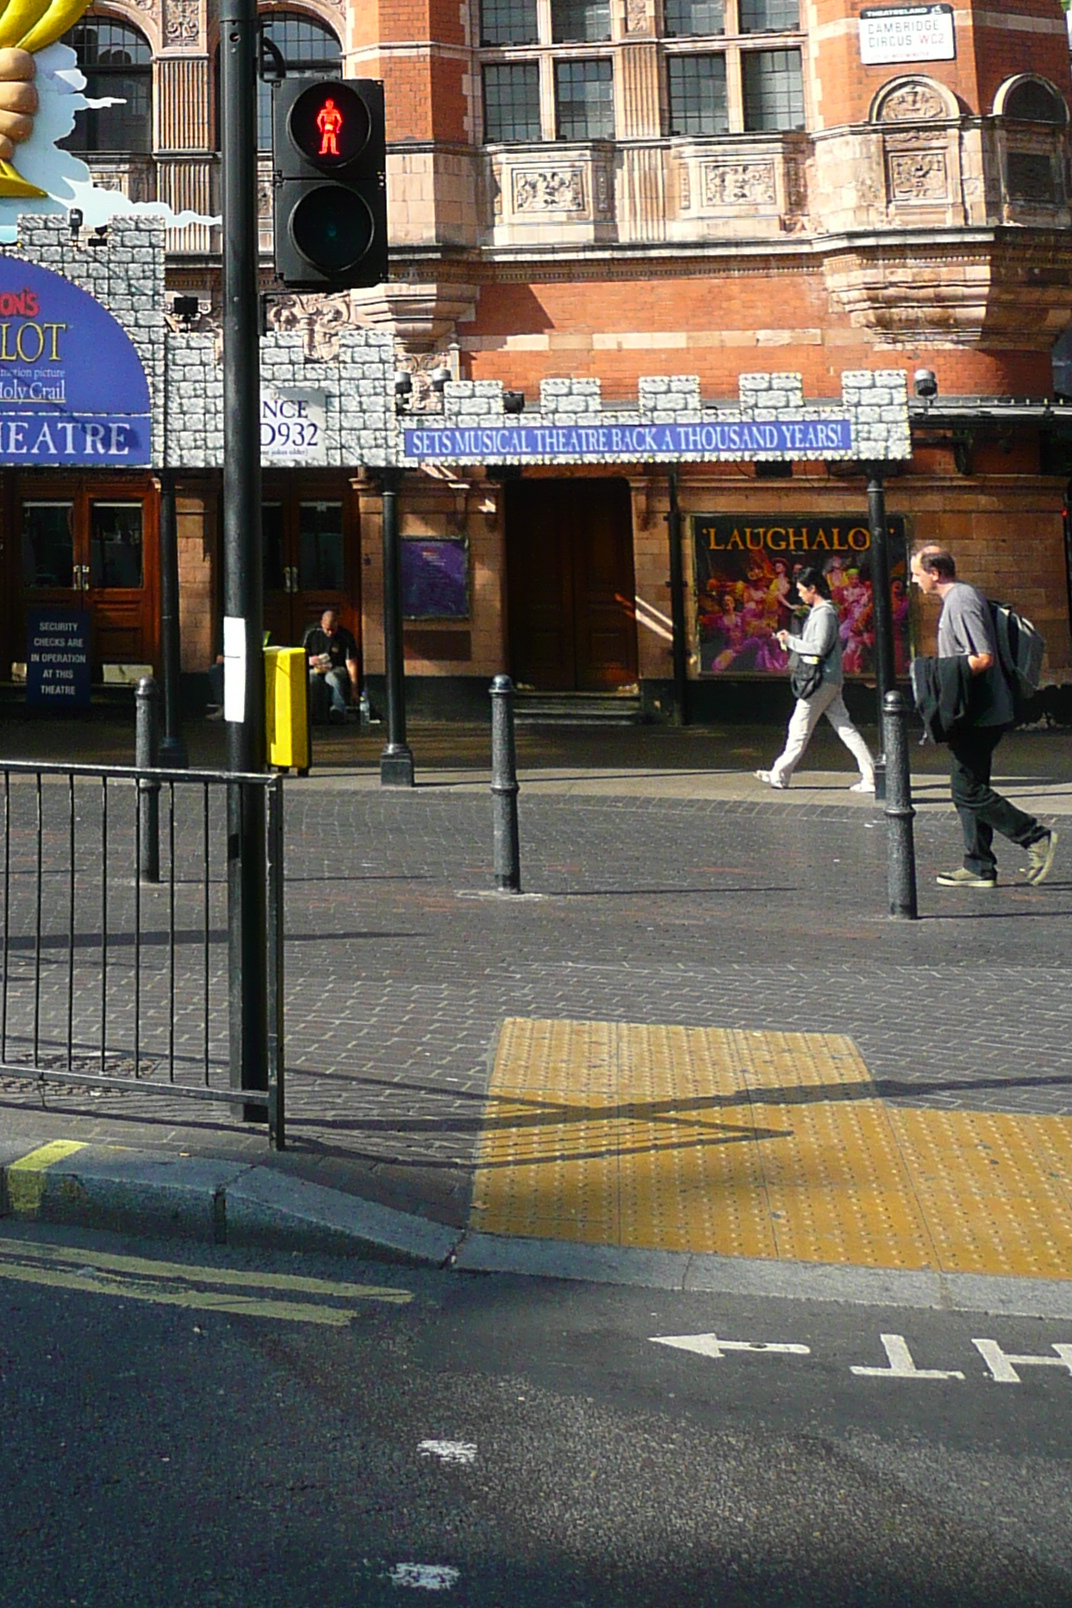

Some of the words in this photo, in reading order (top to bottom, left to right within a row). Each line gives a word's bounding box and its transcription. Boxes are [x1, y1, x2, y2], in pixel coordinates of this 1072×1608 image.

[868, 19, 939, 35] CAMBRIDGE
[868, 35, 913, 48] CIRCUS
[919, 33, 944, 44] WC2
[0, 365, 31, 377] motion
[33, 366, 66, 380] picture
[29, 379, 65, 400] Grail
[263, 400, 308, 419] NCE
[259, 422, 318, 447] D932
[412, 430, 452, 454] SETS
[455, 429, 532, 454] MUSICAL
[534, 428, 609, 453] THEATRE
[611, 427, 658, 451] BACK
[661, 427, 675, 451] A
[678, 425, 778, 451] THOUSAND
[781, 423, 844, 449] YEARS!
[39, 622, 79, 632] SECURITY
[33, 637, 66, 648] CHECKS
[67, 638, 84, 648] ARE
[30, 653, 40, 663] IN
[41, 653, 87, 664] OPERATION
[42, 669, 53, 679] AT
[55, 669, 74, 679] THIS
[40, 684, 76, 696] THEATRE
